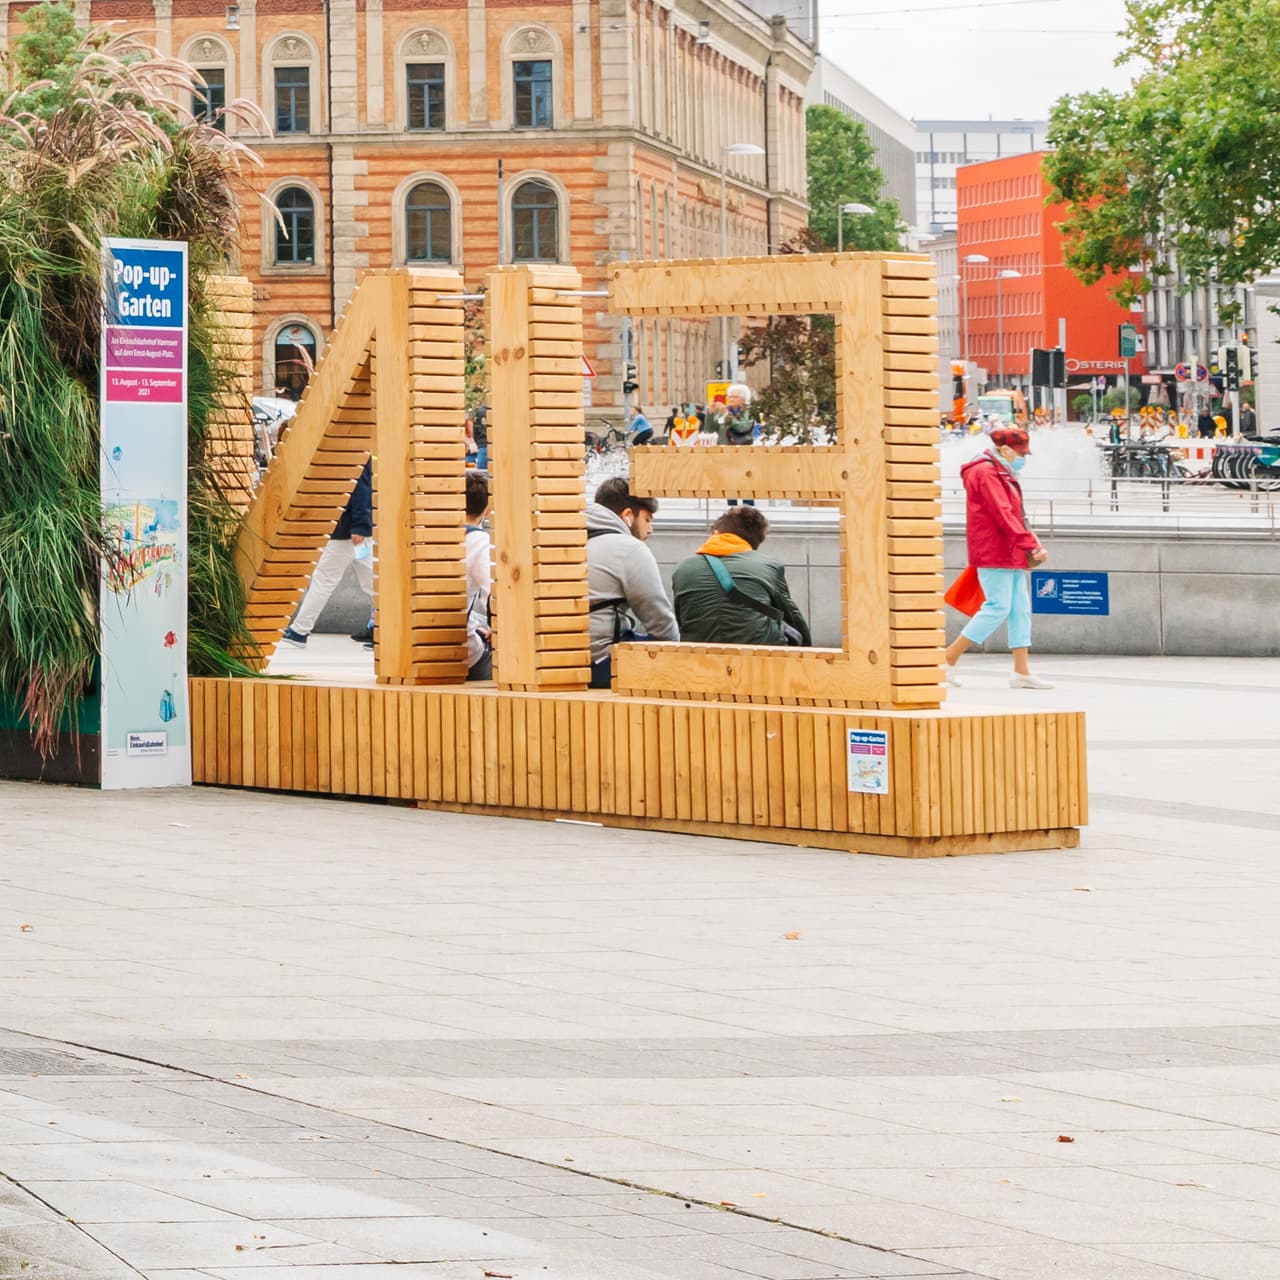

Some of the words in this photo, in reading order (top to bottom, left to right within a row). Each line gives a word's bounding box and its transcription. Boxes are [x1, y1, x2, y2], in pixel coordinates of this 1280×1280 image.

[113, 259, 176, 291] Pop-up-
[118, 291, 171, 318] Garten
[1064, 357, 1127, 372] OSTERIA
